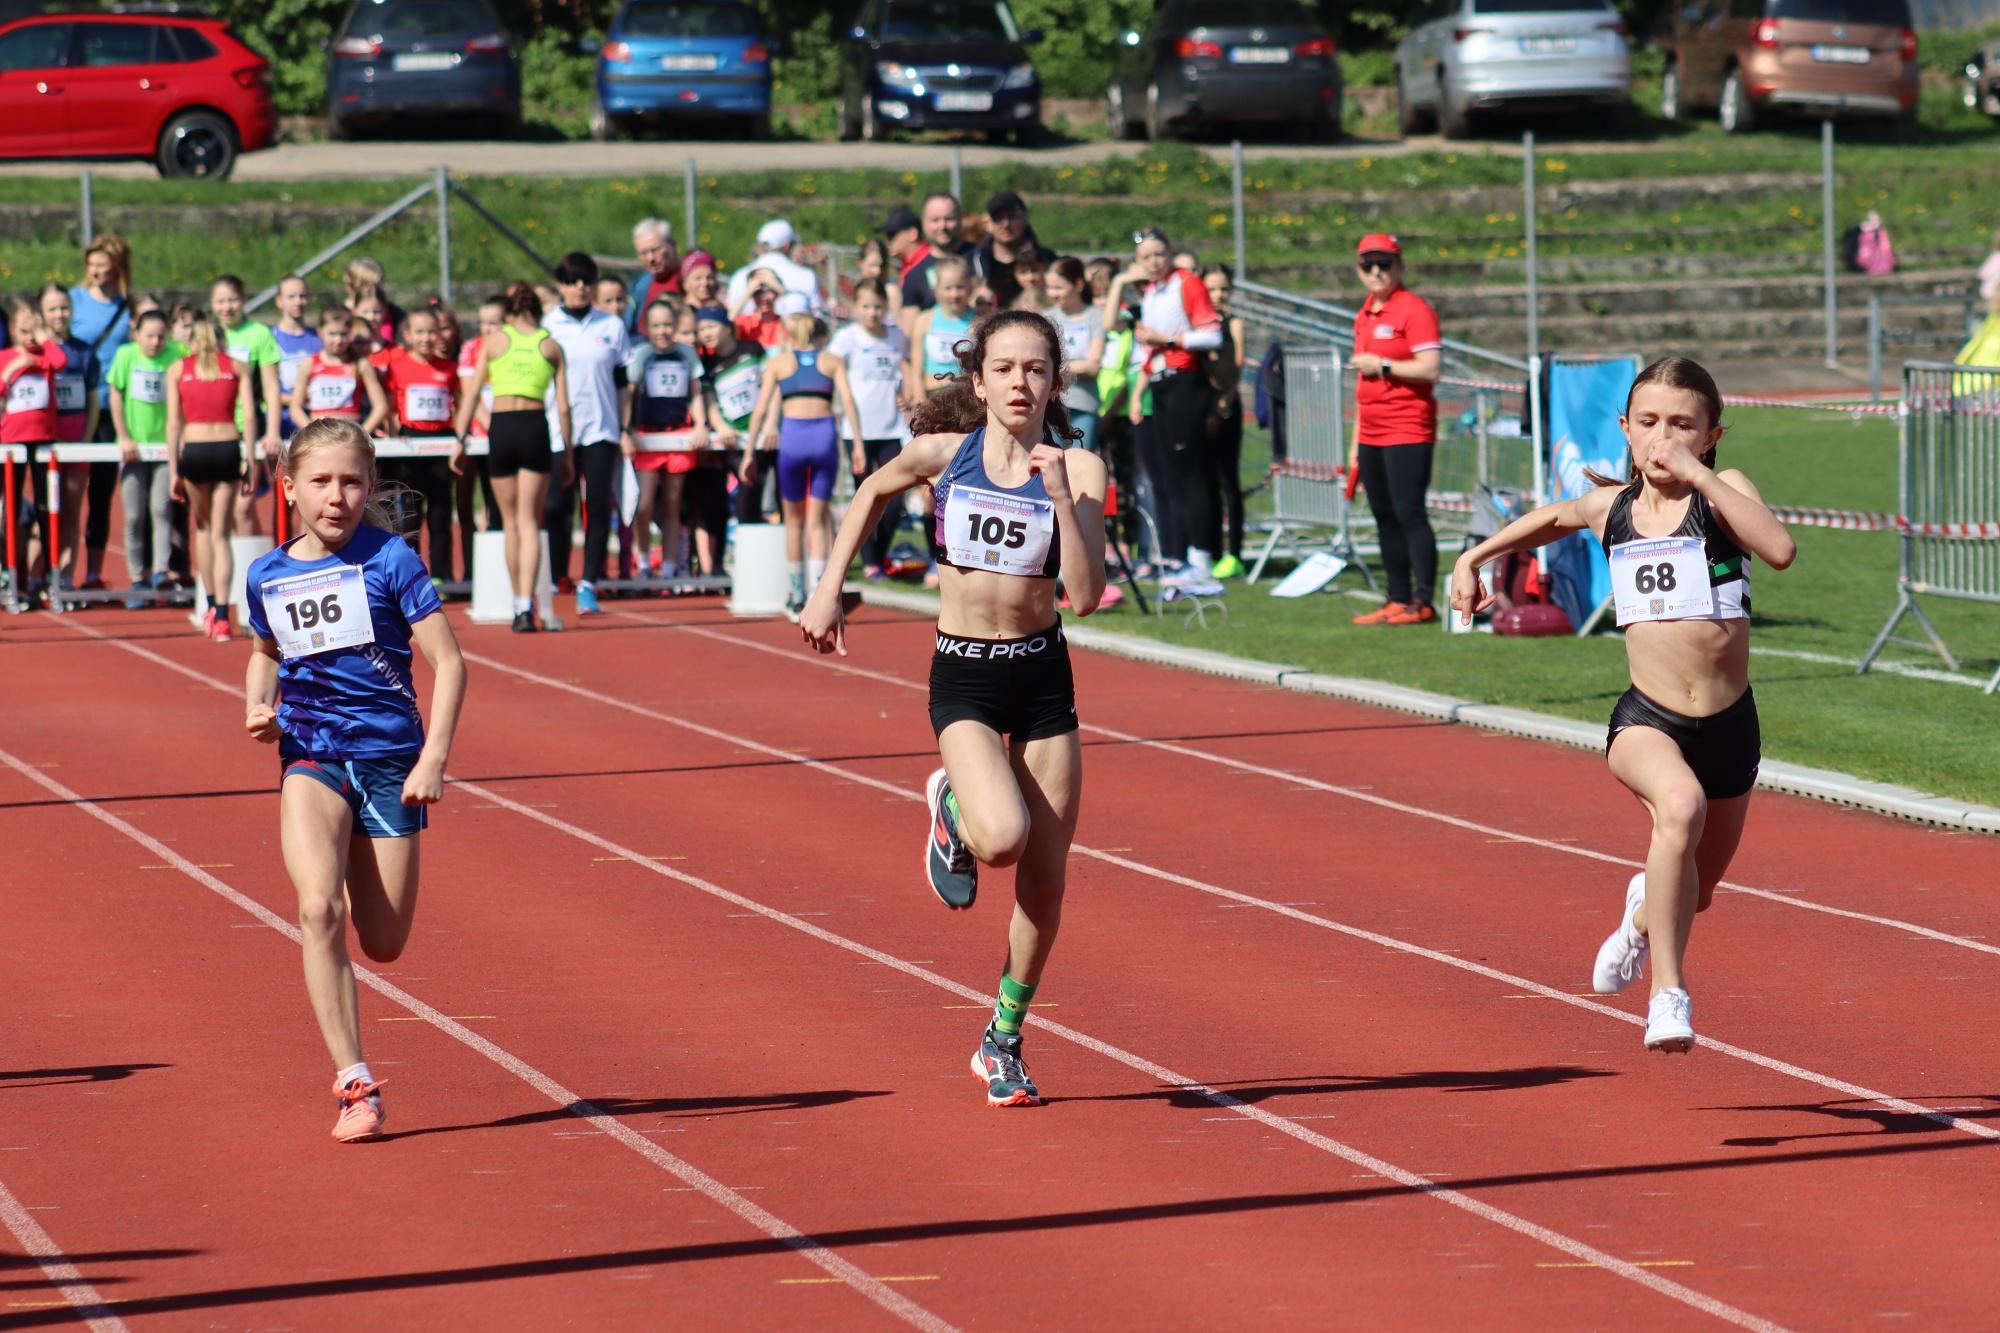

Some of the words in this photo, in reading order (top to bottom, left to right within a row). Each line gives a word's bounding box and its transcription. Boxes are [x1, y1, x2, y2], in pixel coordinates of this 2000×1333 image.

[320, 386, 343, 398] 132
[968, 513, 1027, 549] 105
[1635, 562, 1677, 594] 68
[285, 594, 343, 631] 196
[935, 632, 987, 658] NIKE
[988, 637, 1047, 659] PRO
[363, 645, 404, 689] Slavia
